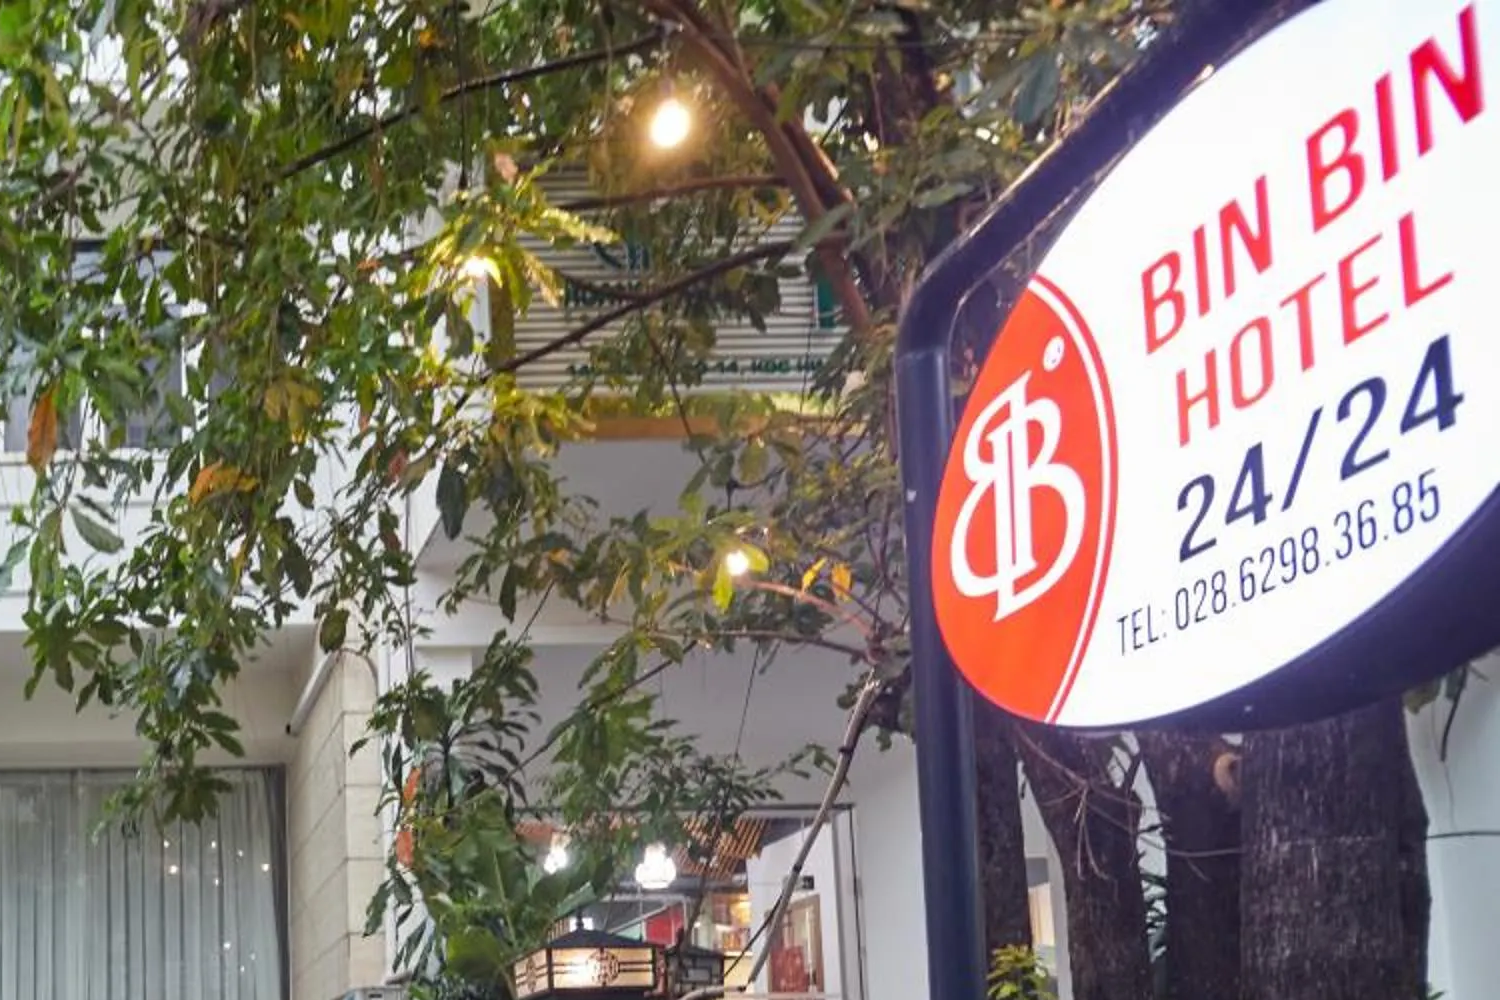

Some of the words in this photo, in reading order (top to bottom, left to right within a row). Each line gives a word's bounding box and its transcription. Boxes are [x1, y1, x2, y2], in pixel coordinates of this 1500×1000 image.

[1141, 174, 1273, 356] BIN
[1305, 2, 1486, 234] BIN
[1174, 210, 1455, 448] HOTEL
[1174, 467, 1442, 633] 028.6298.36.85
[1176, 333, 1465, 564] 24/24
